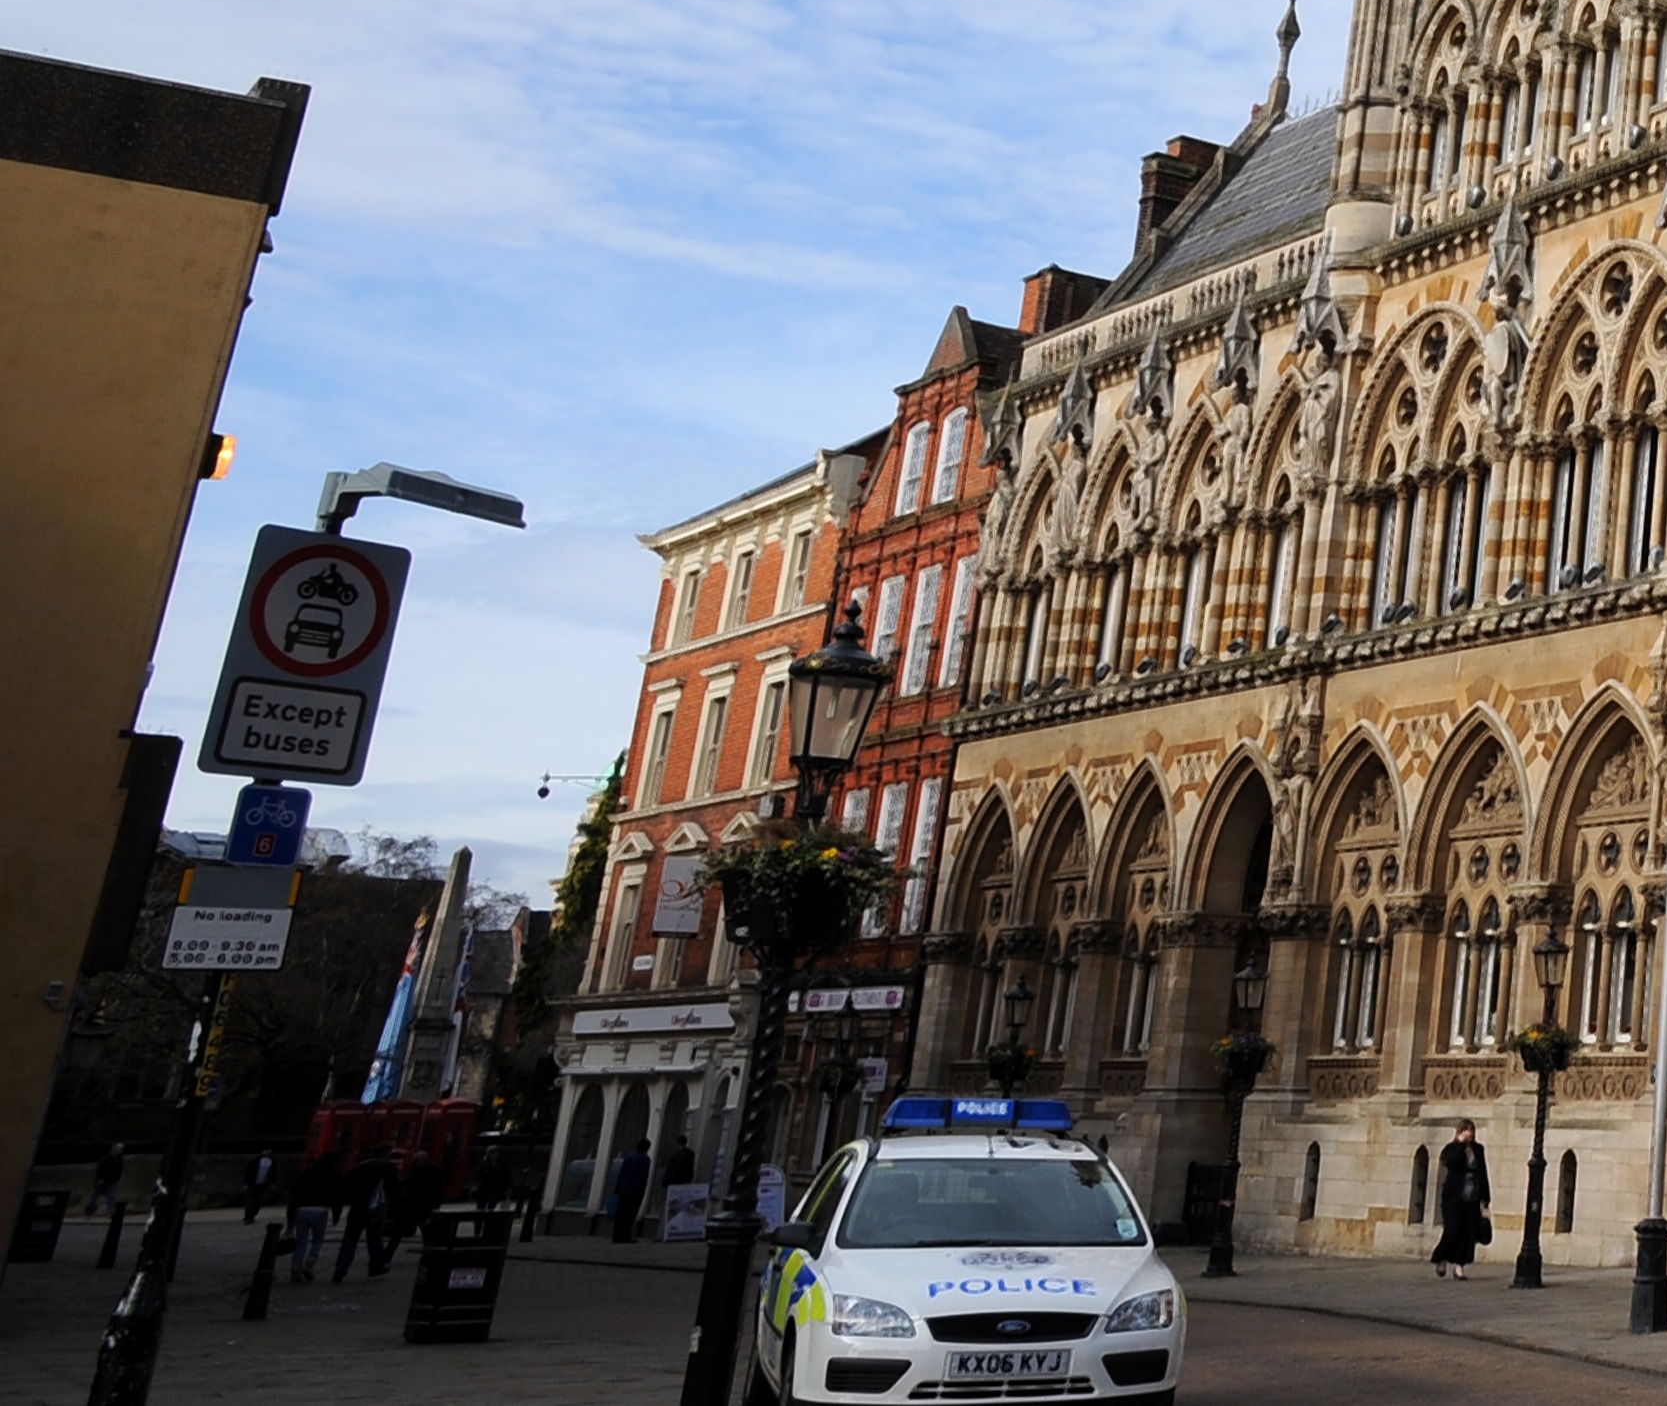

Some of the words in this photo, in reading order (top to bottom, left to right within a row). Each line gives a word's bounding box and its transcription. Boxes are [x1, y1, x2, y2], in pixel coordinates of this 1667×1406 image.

[243, 695, 347, 729] Except
[243, 725, 331, 757] buses
[258, 837, 271, 853] 6
[193, 910, 215, 922] No
[219, 910, 273, 924] loading
[258, 943, 280, 952] am
[956, 1101, 1008, 1115] POLICE
[928, 1277, 1098, 1298] POLICE
[956, 1353, 1014, 1375] KX06
[1019, 1351, 1062, 1374] KYJ
